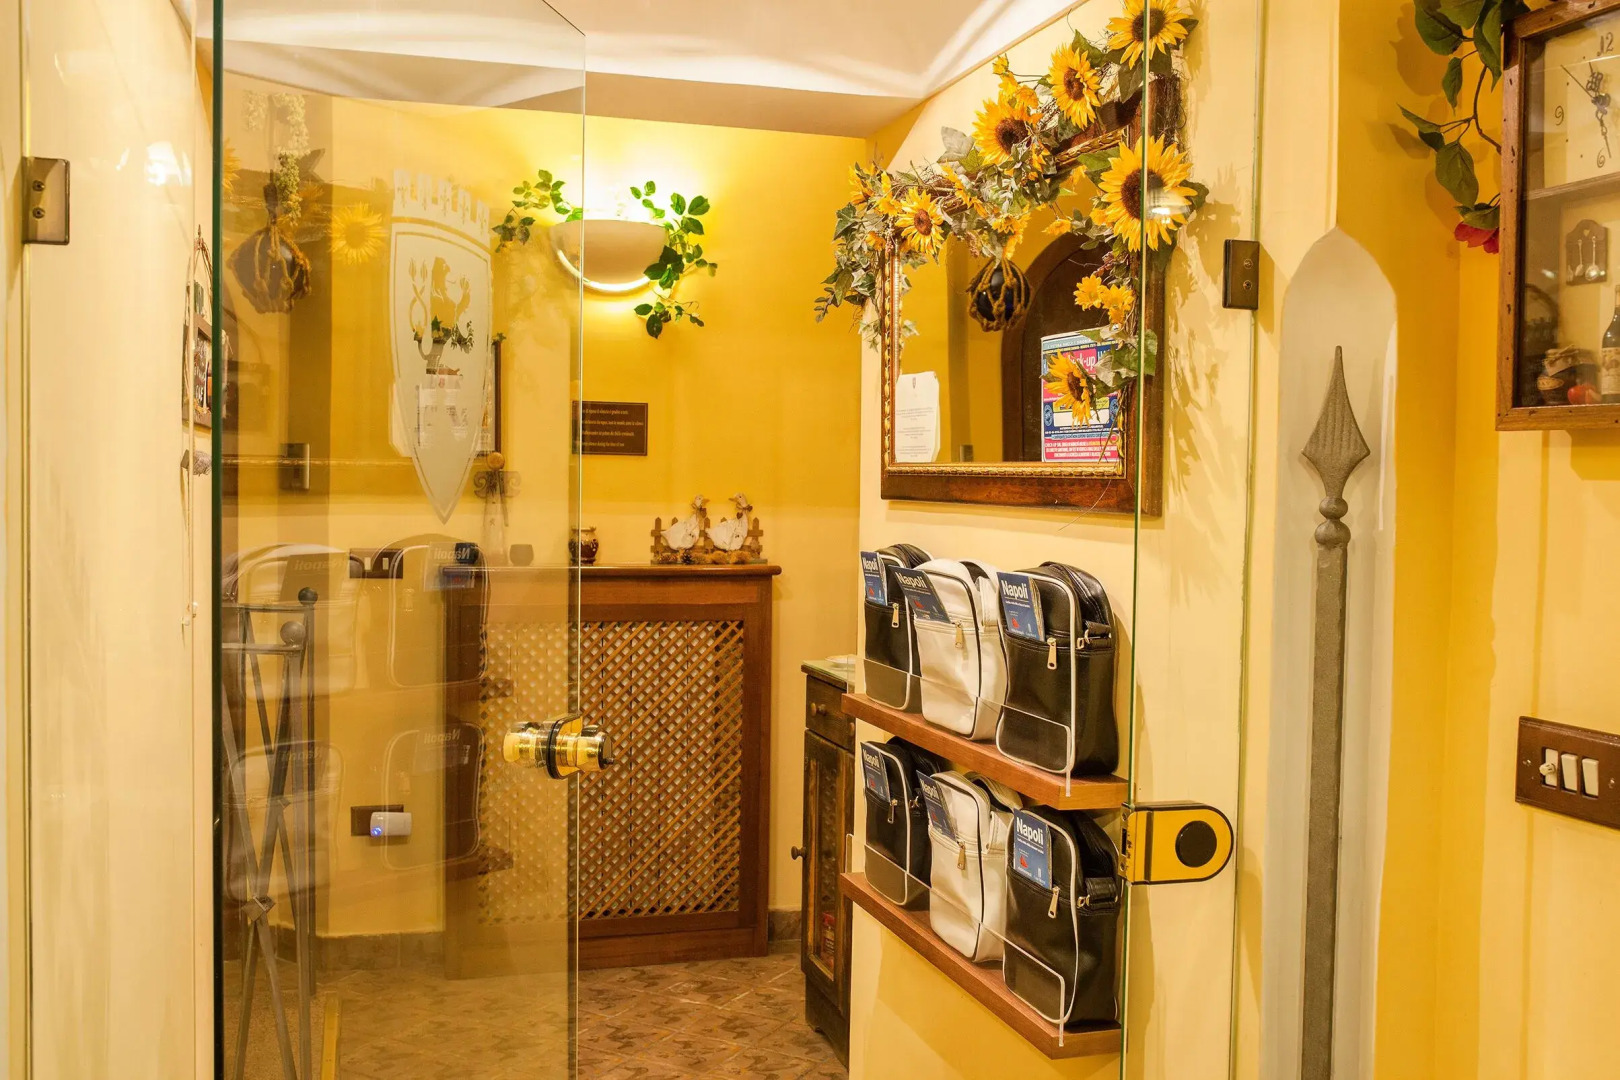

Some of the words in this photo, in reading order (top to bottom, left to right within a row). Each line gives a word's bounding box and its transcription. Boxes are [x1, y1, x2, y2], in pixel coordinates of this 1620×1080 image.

[1597, 31, 1614, 57] 12
[1554, 105, 1565, 126] 9
[1596, 148, 1606, 168] 6
[862, 557, 878, 572] Napoli
[894, 571, 928, 588] Napoli
[1001, 580, 1028, 600] Napoli
[862, 749, 880, 768] Napoli
[919, 778, 940, 800] Napoli
[1016, 816, 1044, 845] Napoli
